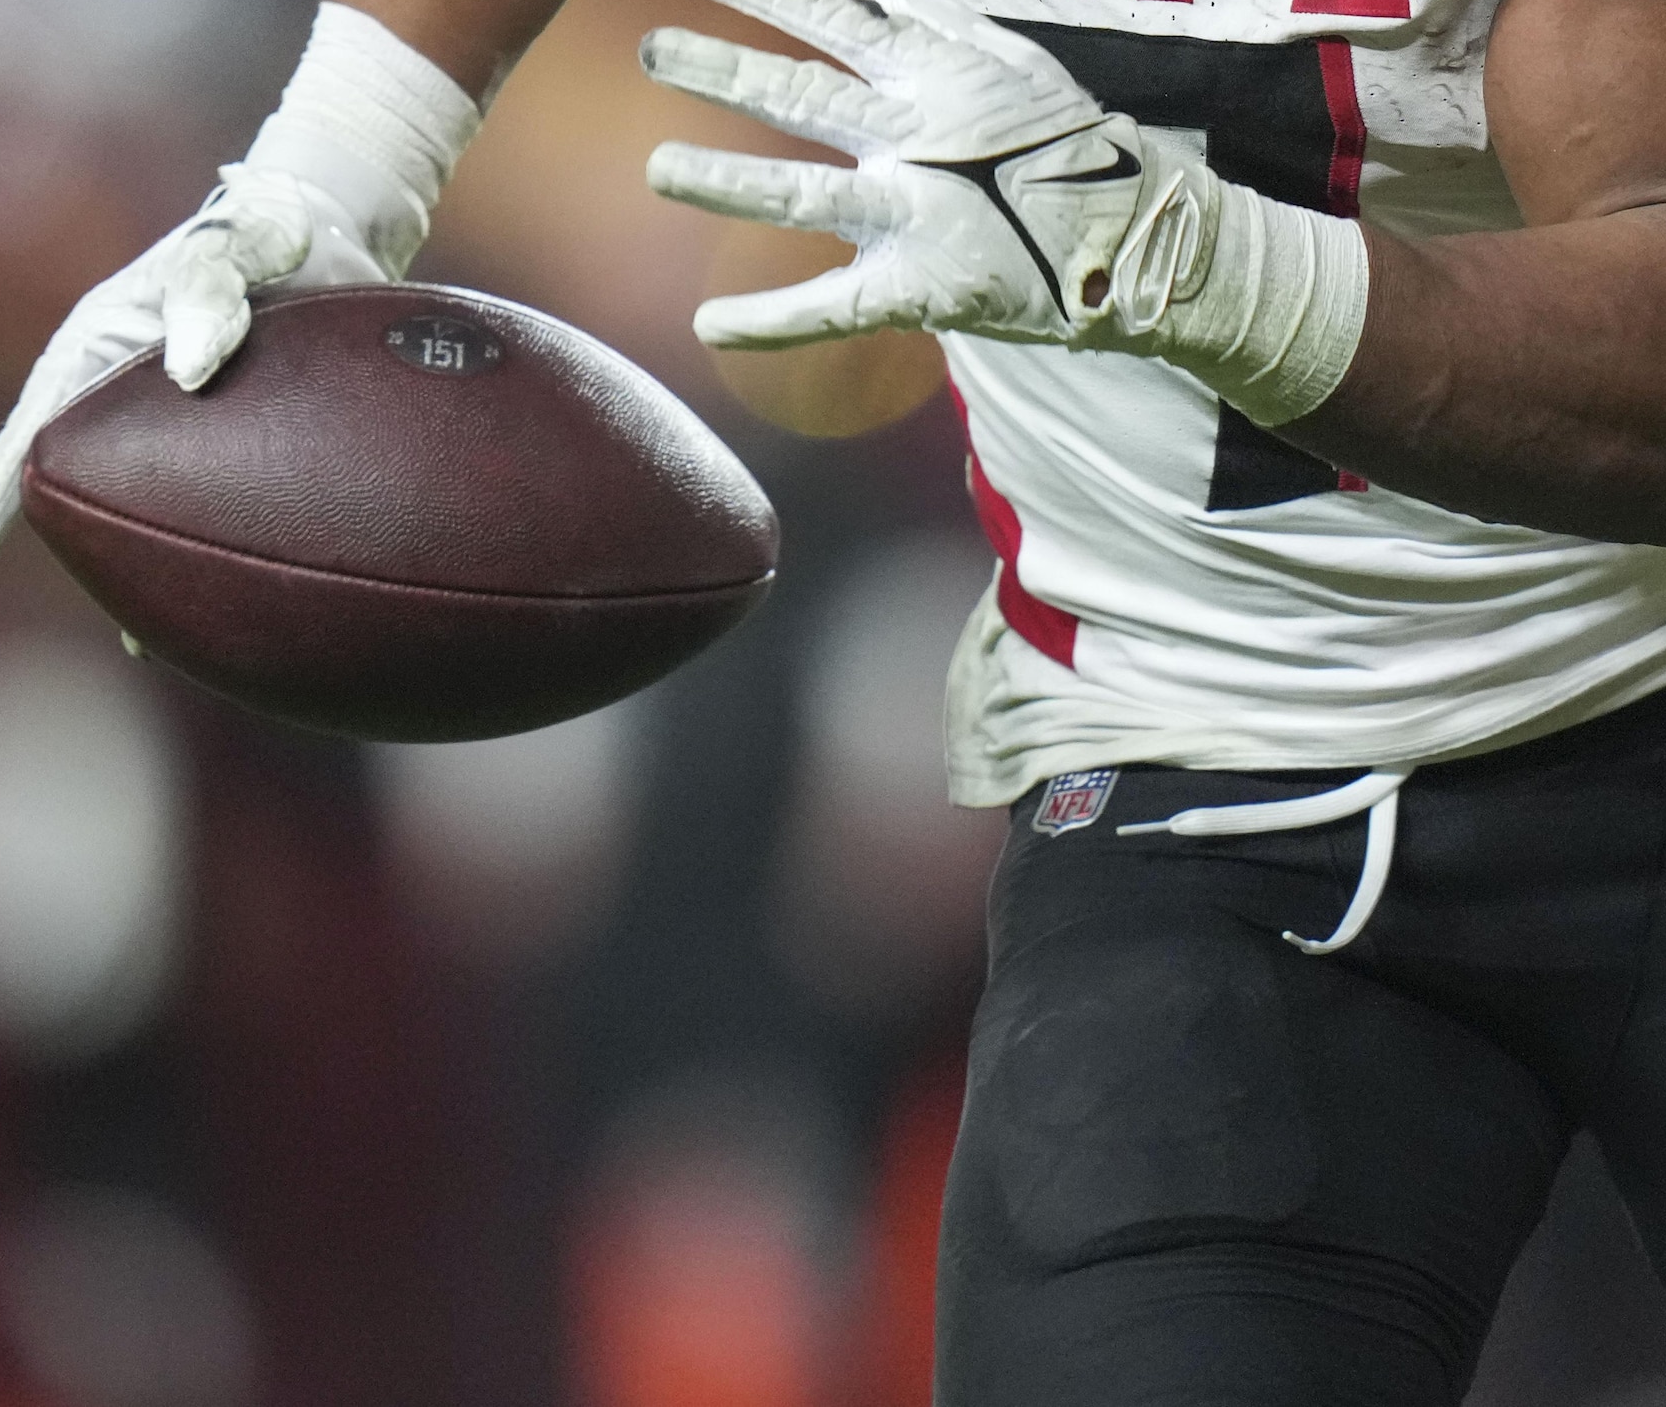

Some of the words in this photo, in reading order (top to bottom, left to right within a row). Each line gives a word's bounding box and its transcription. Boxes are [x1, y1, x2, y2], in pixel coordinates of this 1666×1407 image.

[981, 13, 1367, 511] 7
[422, 338, 464, 370] 151
[1045, 789, 1095, 821] NFL
